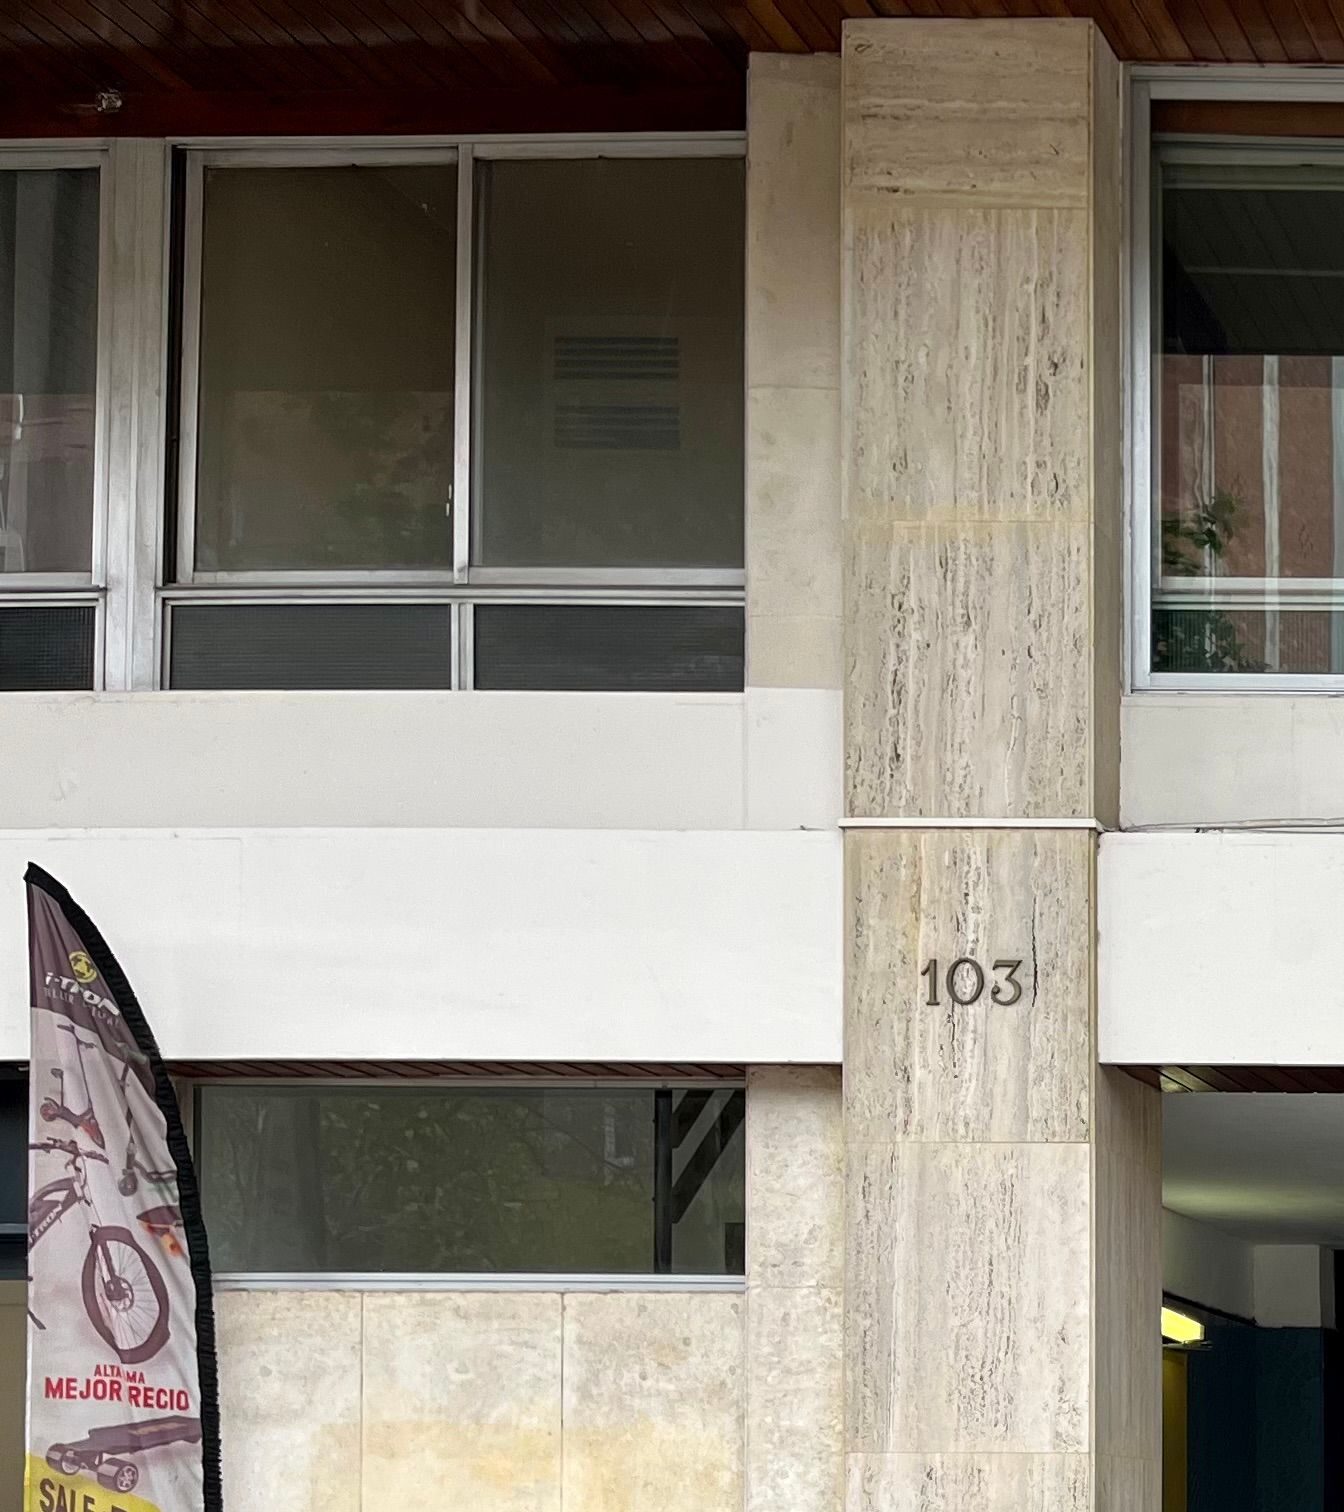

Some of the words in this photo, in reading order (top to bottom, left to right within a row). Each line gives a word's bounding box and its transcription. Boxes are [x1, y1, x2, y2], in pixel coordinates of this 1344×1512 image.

[921, 957, 1023, 1006] 103
[94, 1364, 122, 1378] ALTA
[44, 1376, 123, 1401] MEJOR
